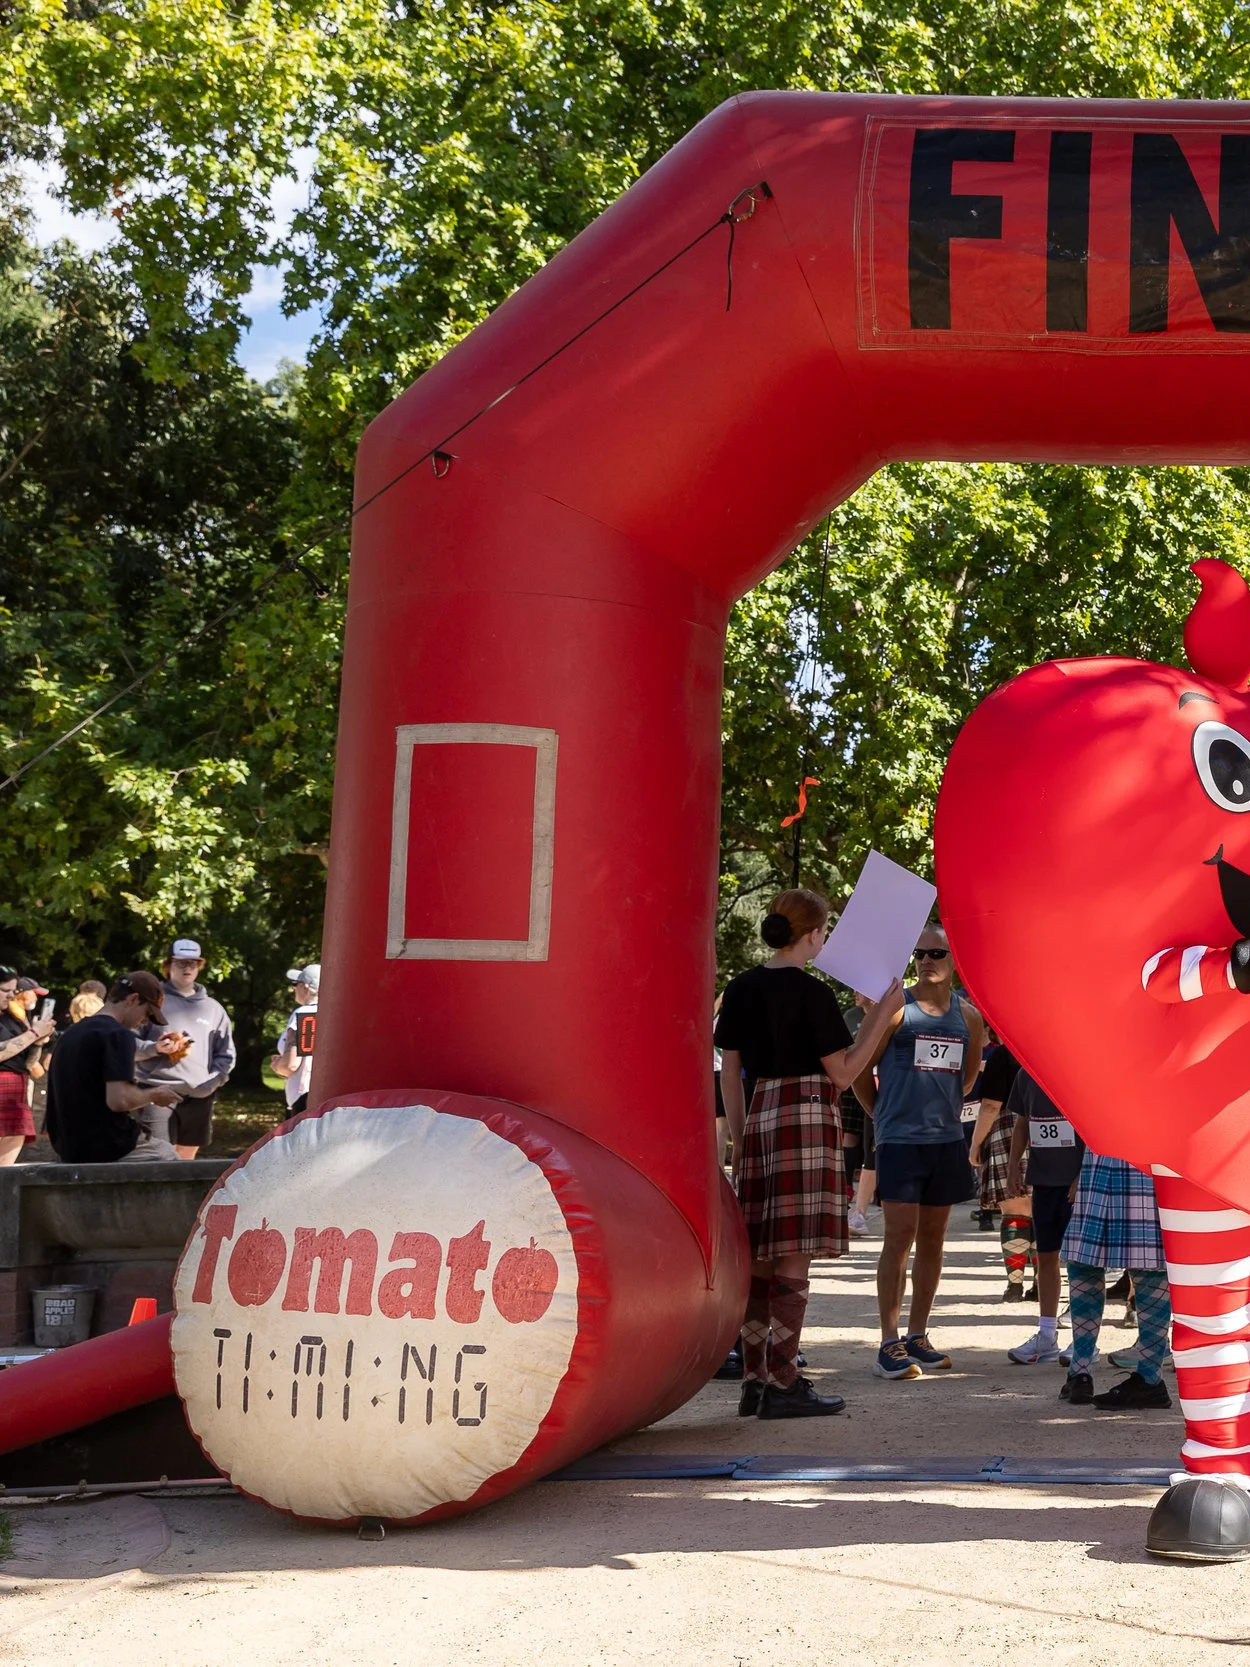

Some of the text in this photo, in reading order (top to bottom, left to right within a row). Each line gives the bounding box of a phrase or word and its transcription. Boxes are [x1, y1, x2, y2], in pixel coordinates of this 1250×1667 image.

[930, 1043, 949, 1059] 37
[1040, 1124, 1058, 1139] 38
[192, 1204, 559, 1324] Tomato
